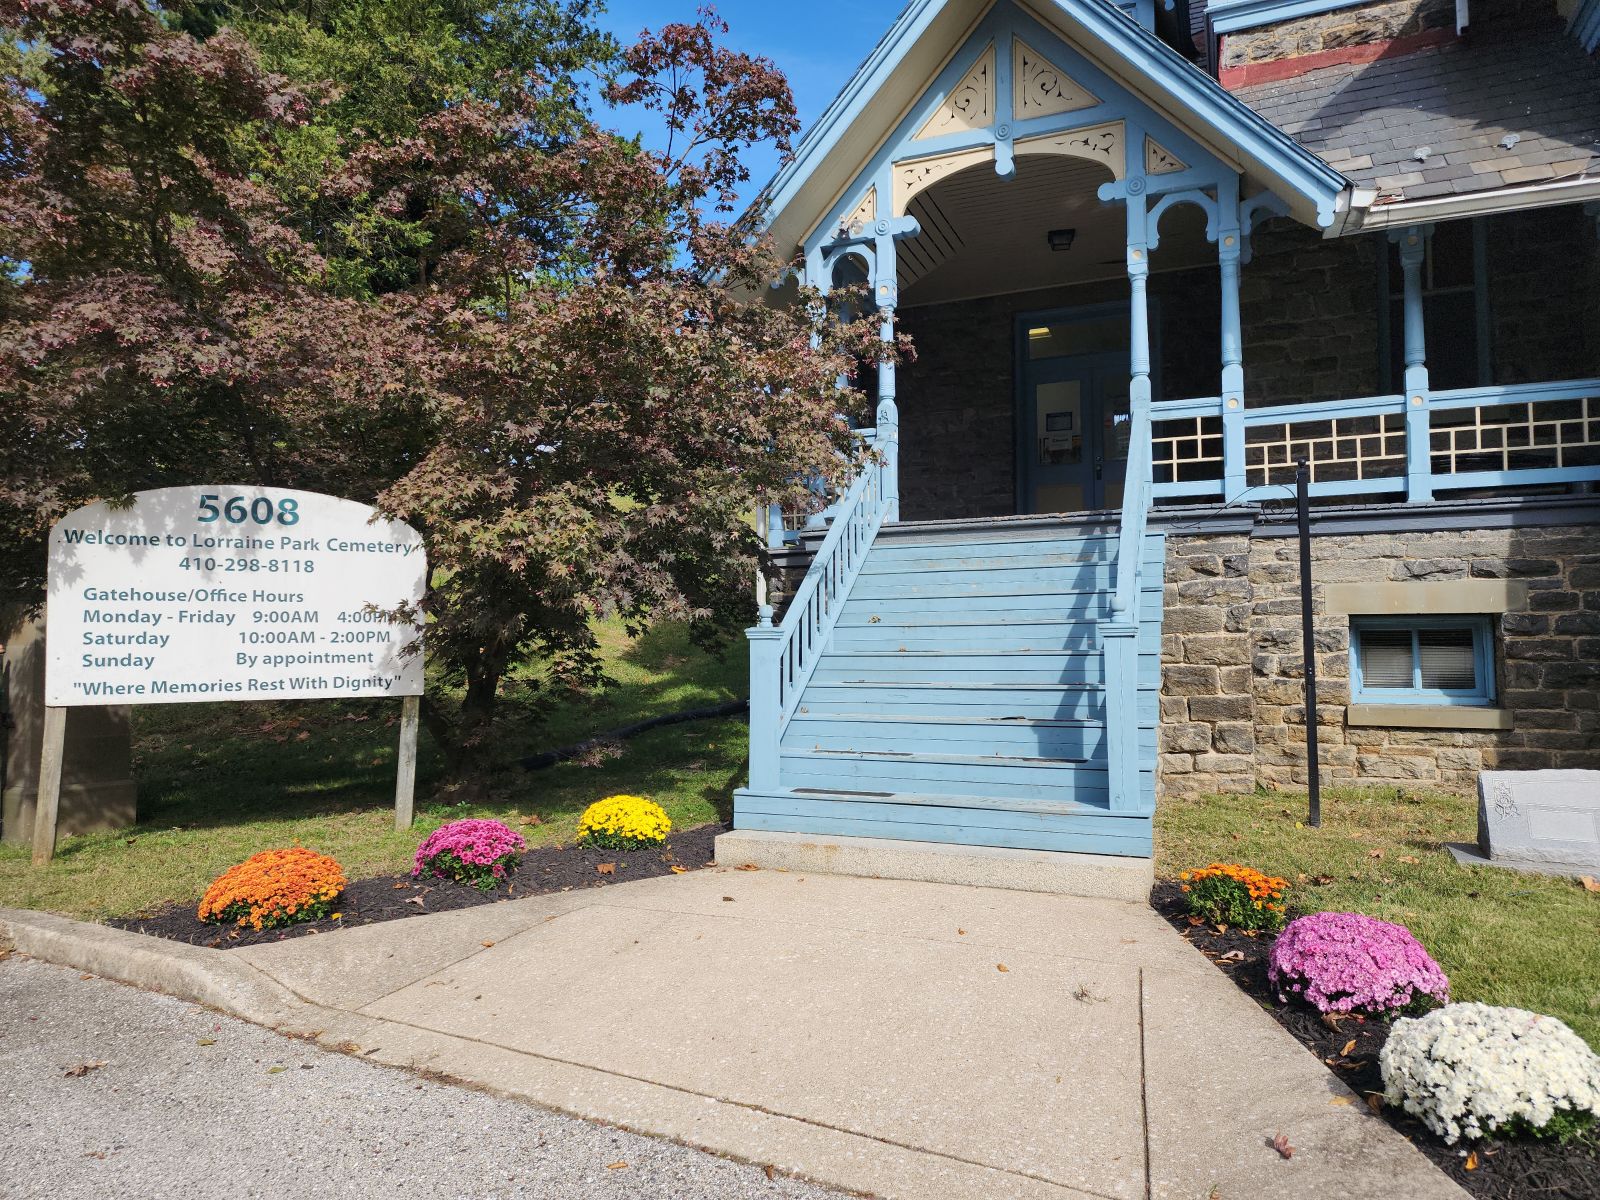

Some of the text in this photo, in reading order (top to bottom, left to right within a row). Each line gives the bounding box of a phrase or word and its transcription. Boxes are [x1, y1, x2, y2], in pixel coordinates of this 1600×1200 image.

[197, 494, 300, 525] 5608
[64, 529, 412, 556] Welcome to Lorraine Park Cemetery
[179, 557, 315, 573] 410-298-8118
[83, 587, 304, 603] Gatehouse/Office Hours
[83, 610, 163, 625] Monday
[179, 610, 235, 626] Friday
[253, 610, 319, 624] 9:00AM
[83, 631, 170, 647] Saturday
[239, 631, 315, 644] 10:00AM
[330, 631, 391, 644] 2:00PM
[82, 651, 374, 669] Sunday By appointment
[73, 675, 401, 695] "Where Memories Rest With Dignity"
